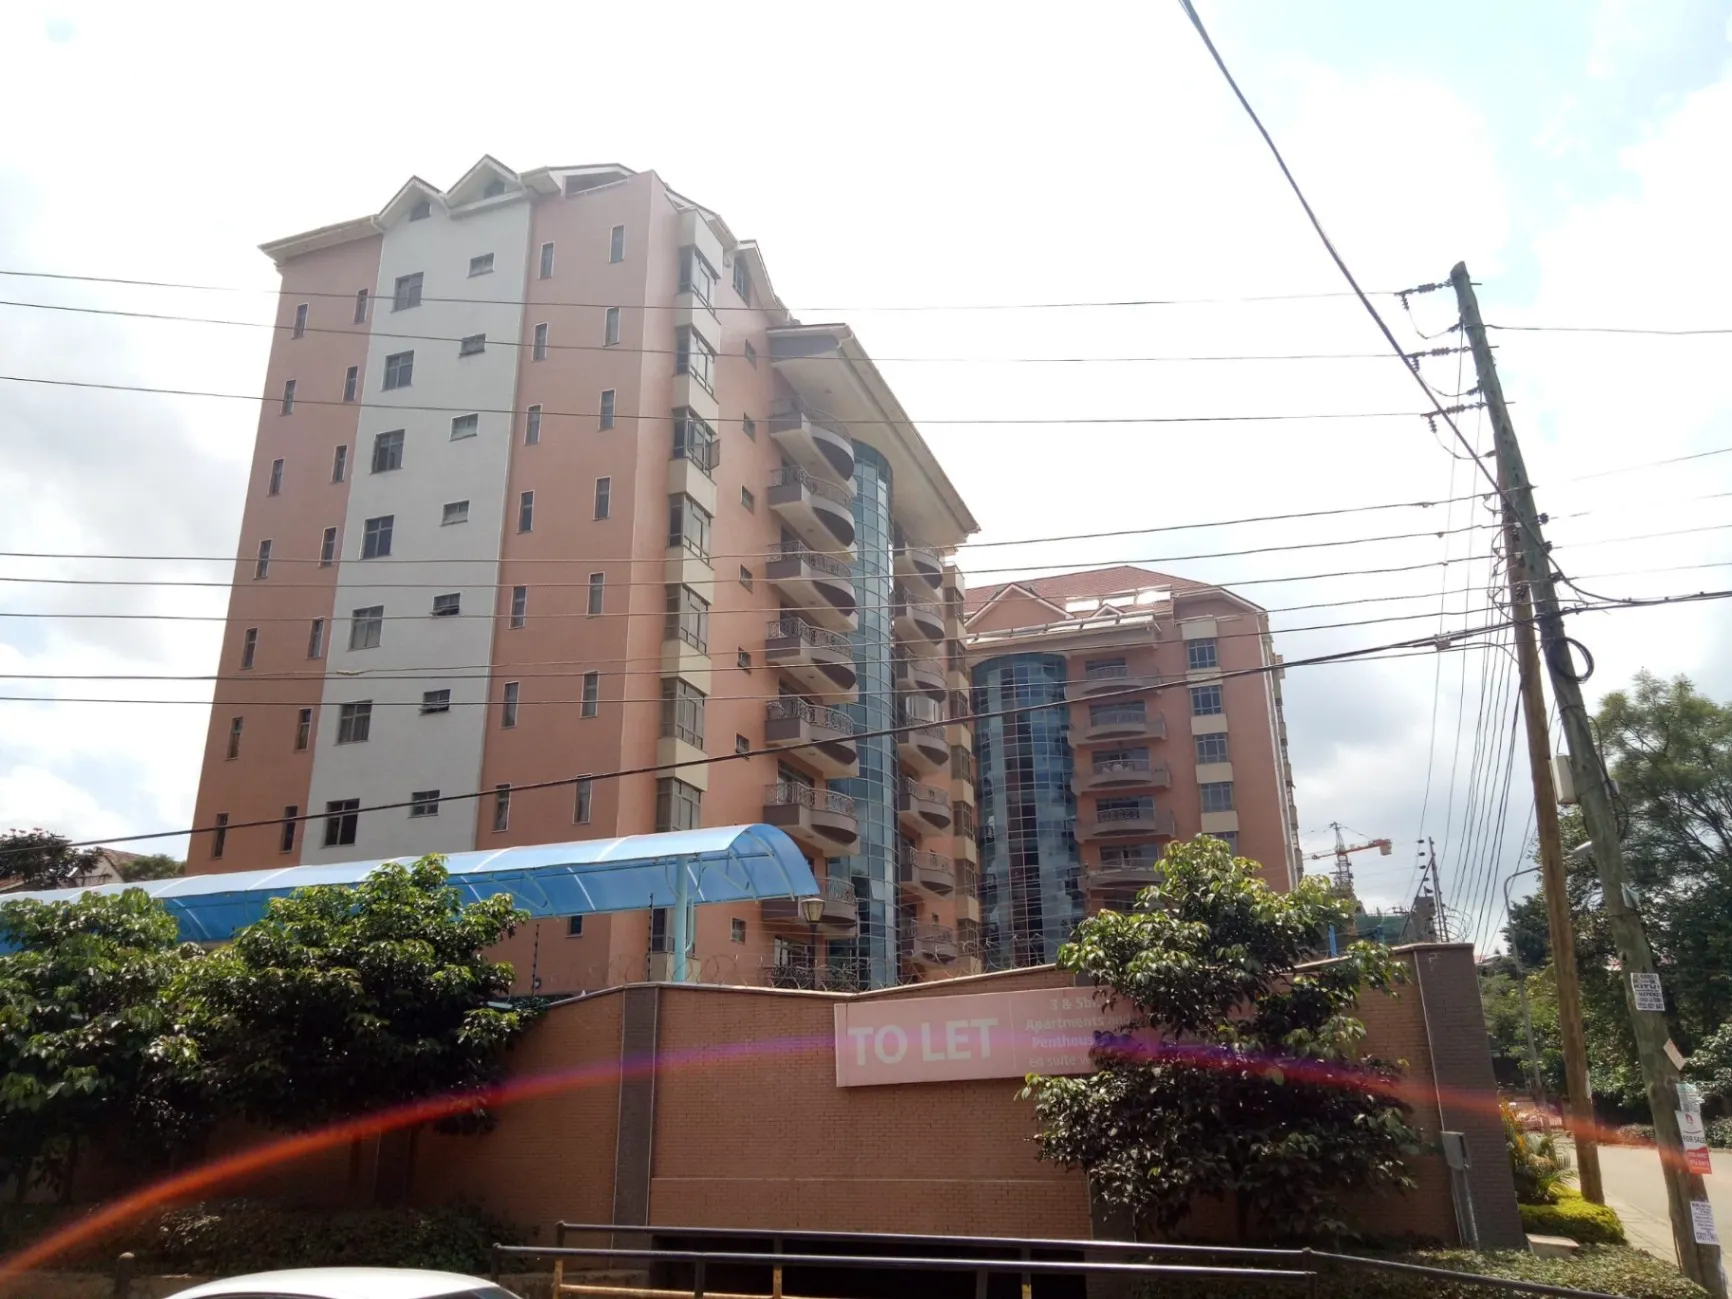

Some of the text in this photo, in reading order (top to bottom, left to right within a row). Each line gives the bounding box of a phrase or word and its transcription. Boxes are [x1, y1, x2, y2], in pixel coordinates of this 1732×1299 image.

[1050, 998, 1059, 1011] 3
[1062, 998, 1072, 1011] &
[1026, 1016, 1105, 1033] Apartments
[847, 1018, 998, 1066] TO LET
[1032, 1034, 1100, 1049] Penthous
[1047, 1054, 1076, 1067] suite
